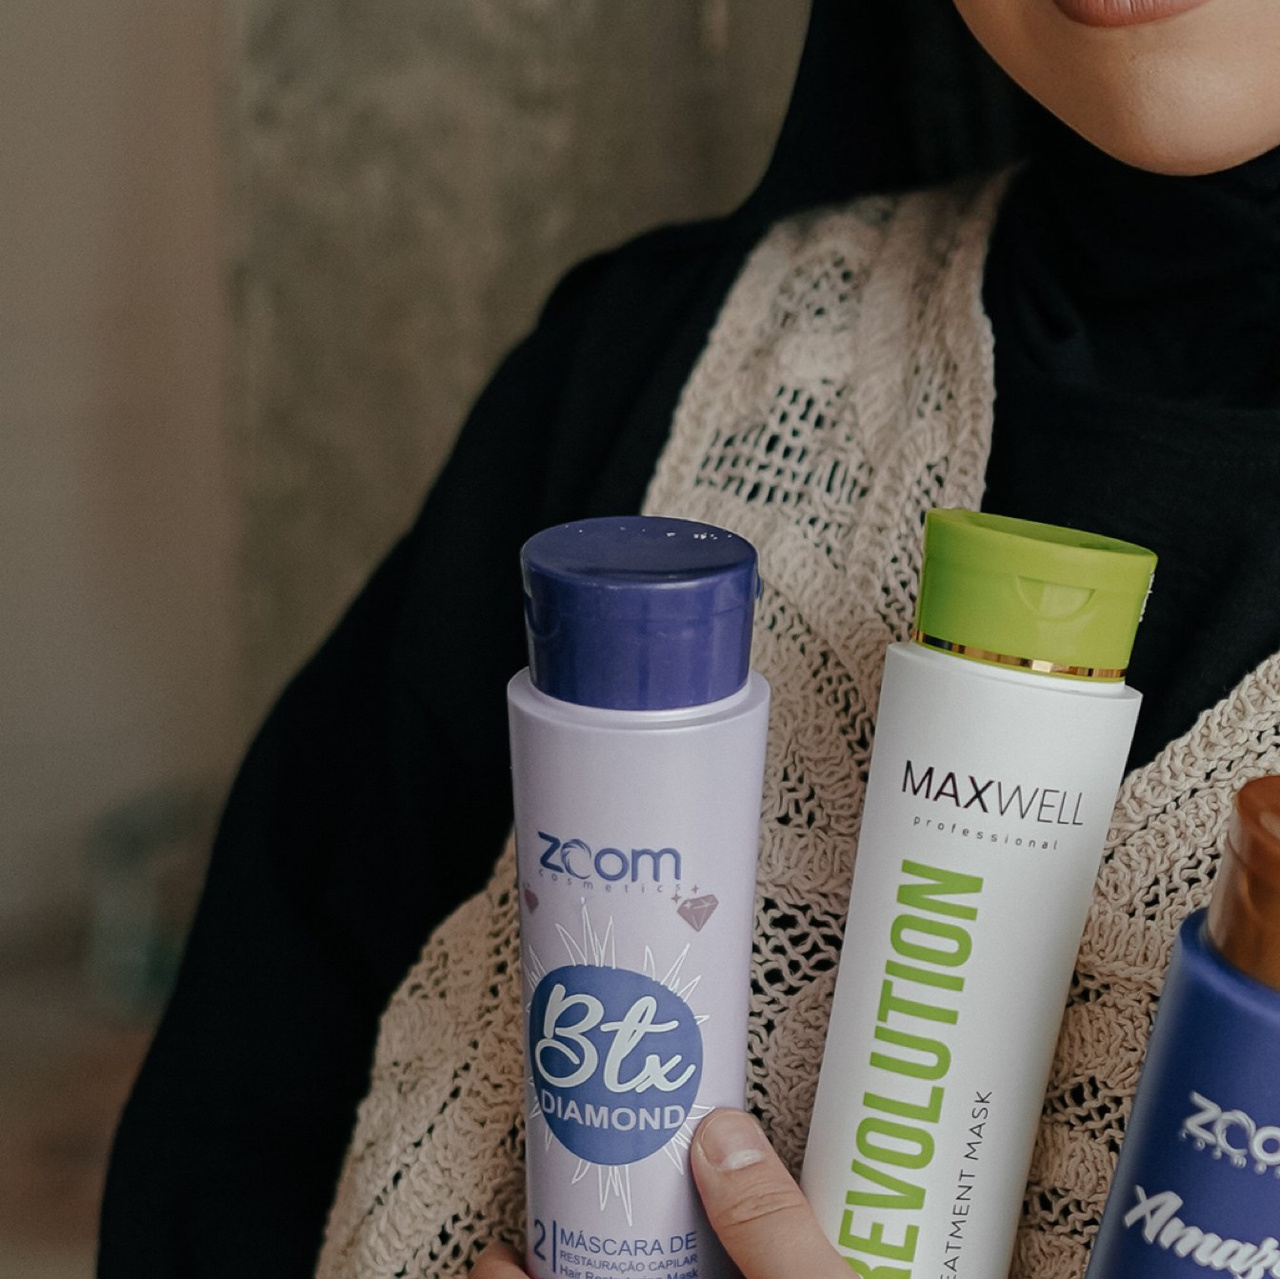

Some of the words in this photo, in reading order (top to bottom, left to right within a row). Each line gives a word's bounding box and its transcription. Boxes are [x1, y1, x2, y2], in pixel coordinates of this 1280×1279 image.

[902, 759, 1084, 826] MAXWELL
[913, 815, 1059, 851] professional
[535, 983, 697, 1093] Btx
[541, 1089, 686, 1131] DIAMOND
[963, 1089, 993, 1161] MASK
[559, 1228, 664, 1256] MÁSCARA
[670, 1230, 699, 1252] DE
[560, 1250, 645, 1274] RESTAURAÇÃO
[648, 1253, 699, 1272] CAPILAR
